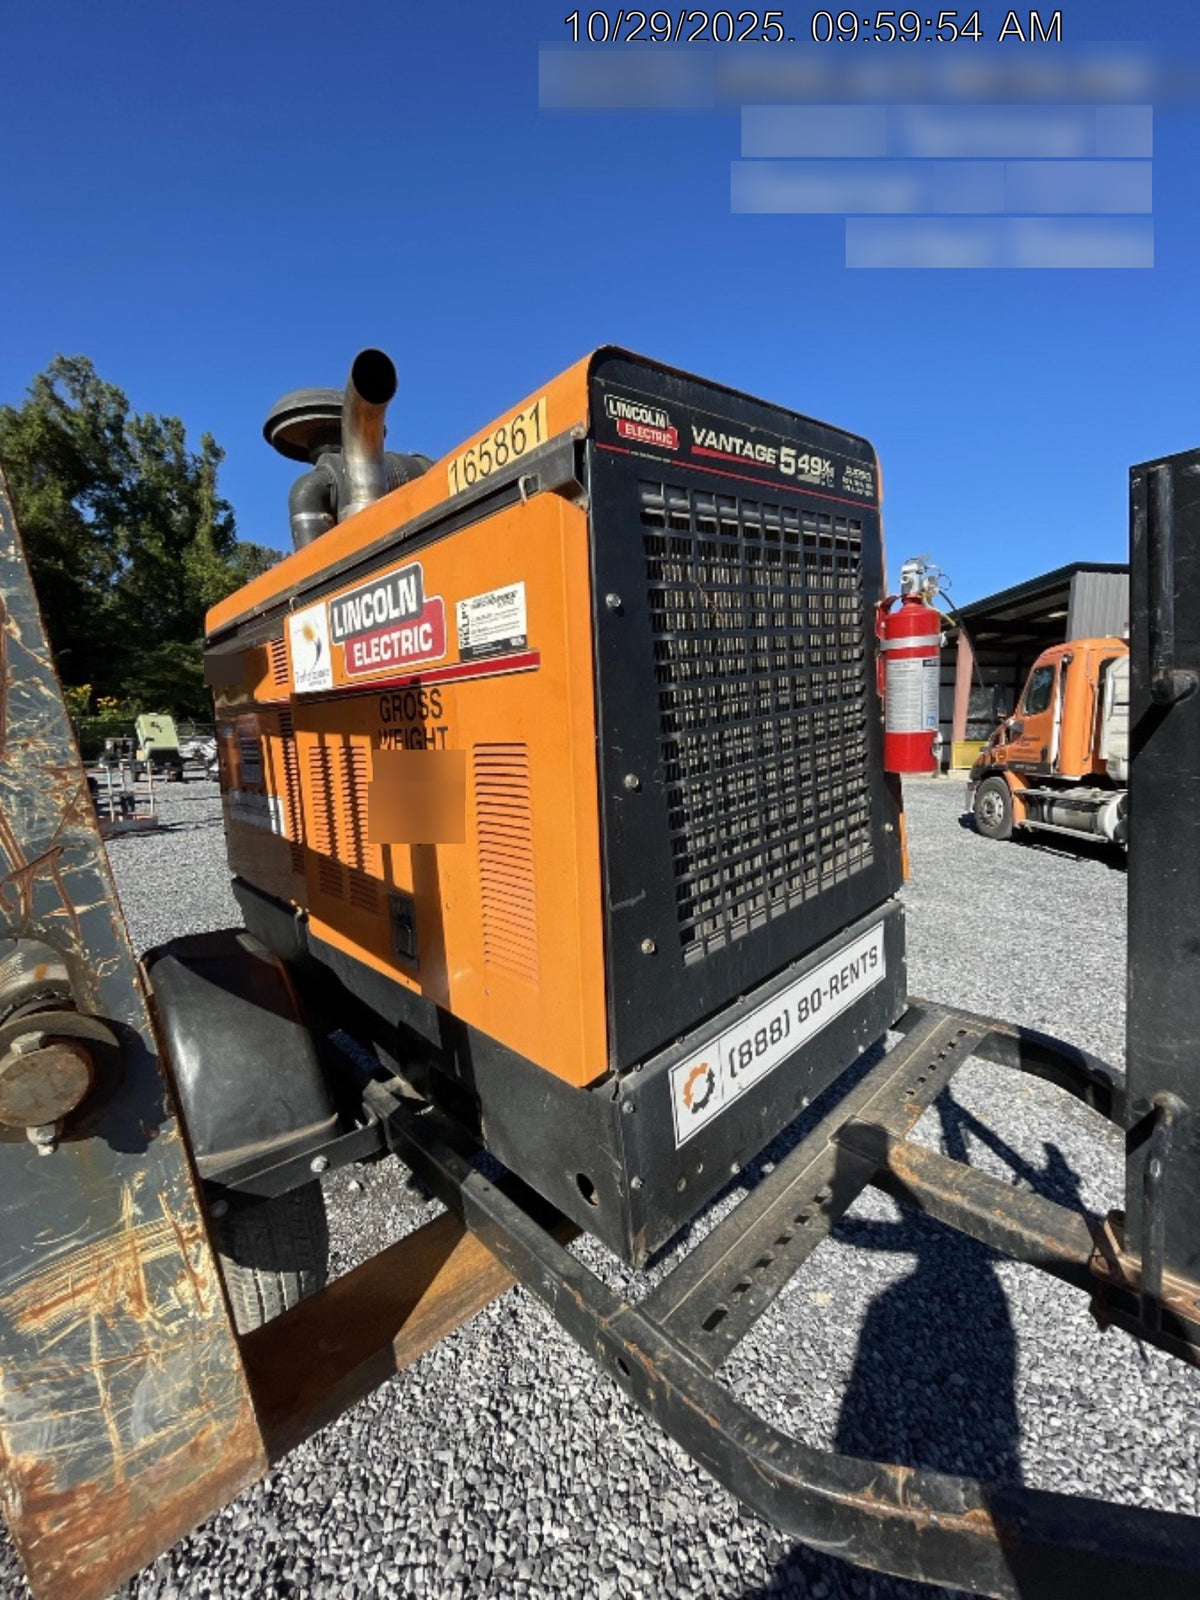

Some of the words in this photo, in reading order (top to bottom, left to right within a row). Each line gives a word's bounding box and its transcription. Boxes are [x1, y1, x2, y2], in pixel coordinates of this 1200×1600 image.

[608, 398, 666, 429] LINCOLN
[624, 422, 673, 446] ELECTRIC
[449, 401, 542, 495] 165861
[691, 425, 778, 466] VANTAGE
[331, 573, 418, 638] LINCOLN
[352, 622, 434, 668] ELECTRIC
[379, 687, 443, 724] GROSS
[728, 1009, 792, 1079] (888)
[797, 945, 879, 1024] 80-RENTS
